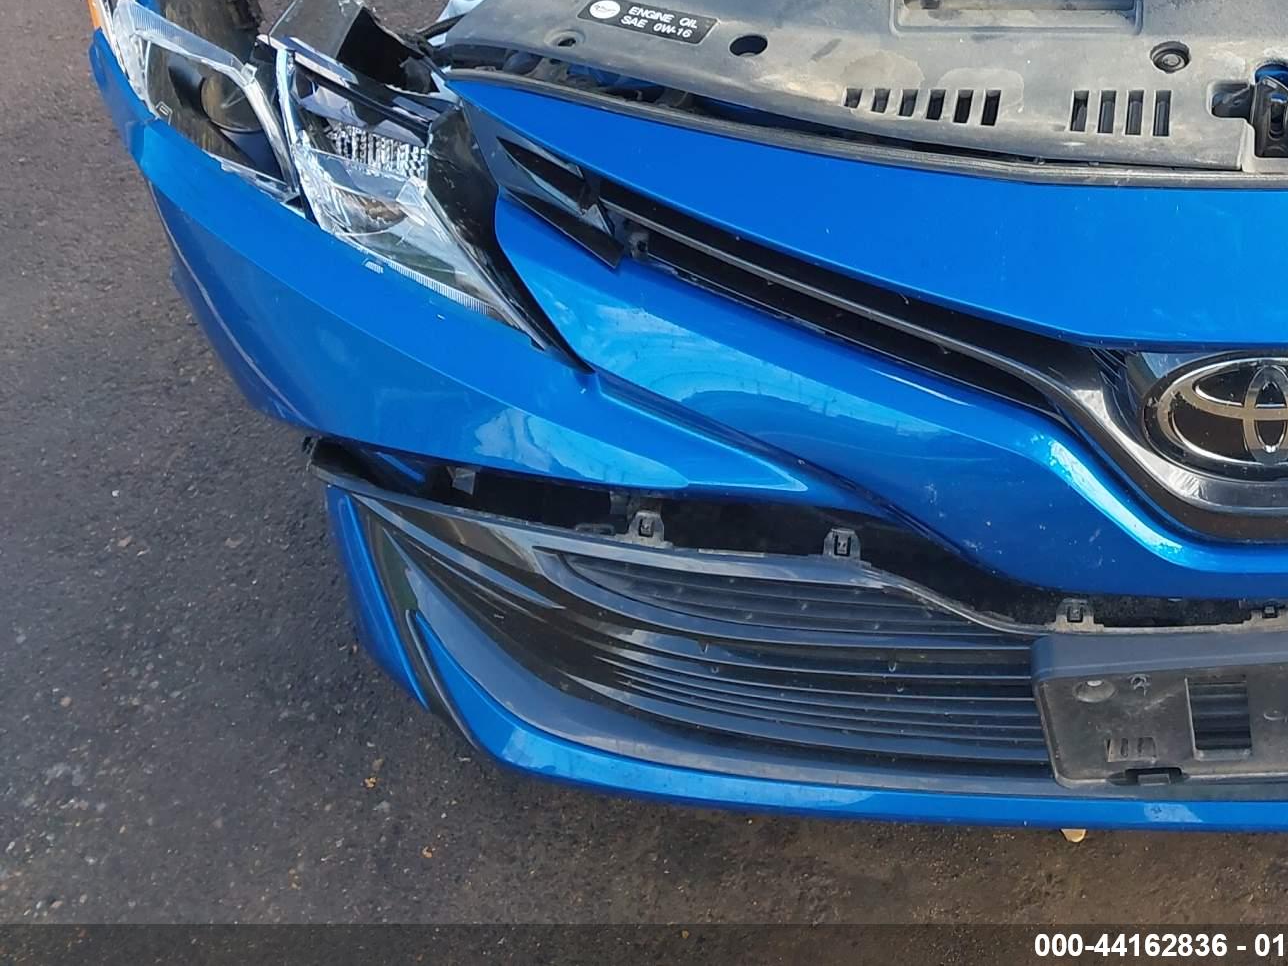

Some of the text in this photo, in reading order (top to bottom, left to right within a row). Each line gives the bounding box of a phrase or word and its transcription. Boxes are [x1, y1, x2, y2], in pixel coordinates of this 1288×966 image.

[621, 16, 692, 37] SAE 0W-16
[629, 6, 698, 29] ENGINE OIL
